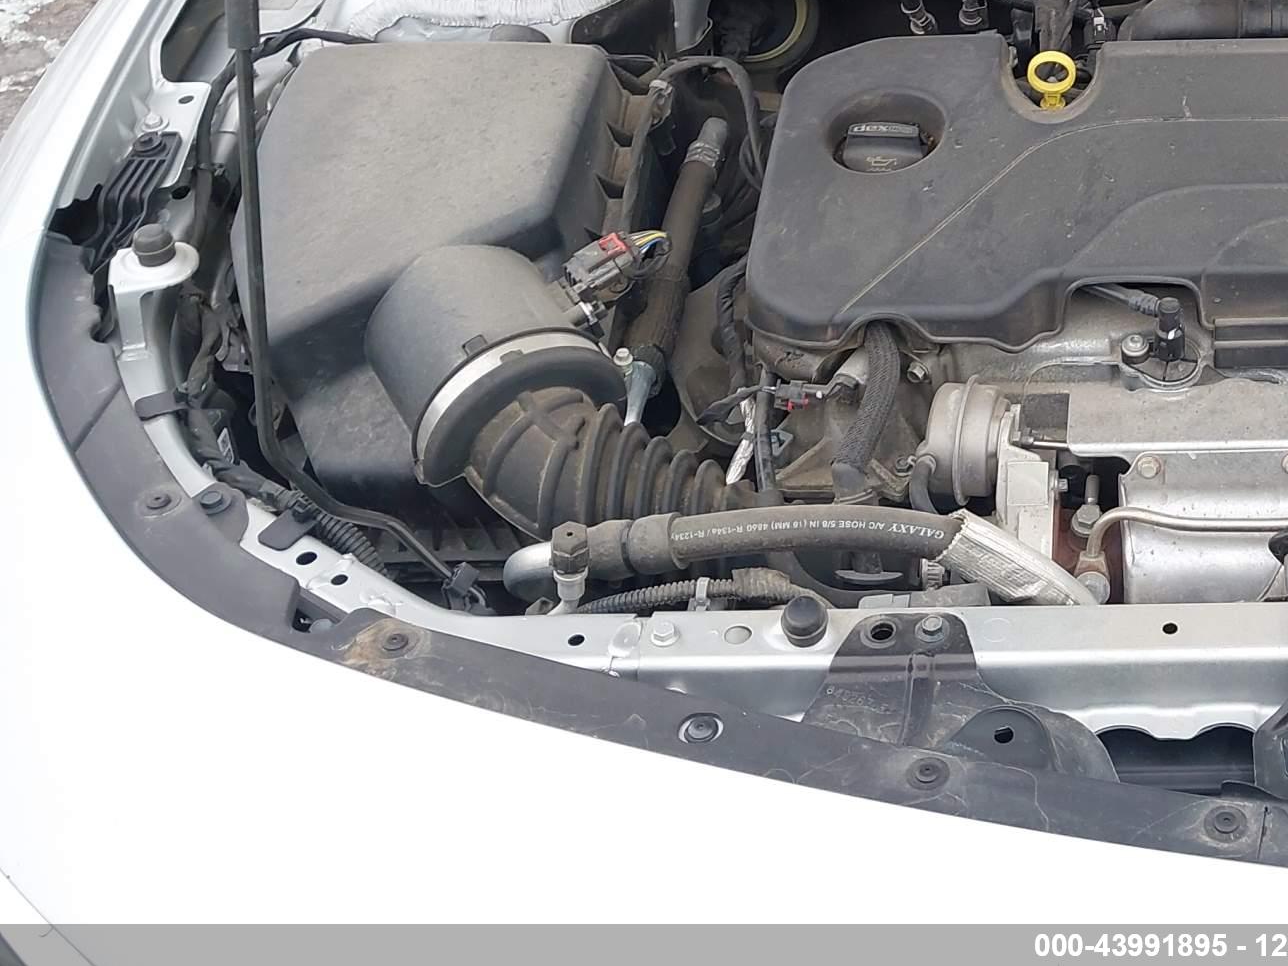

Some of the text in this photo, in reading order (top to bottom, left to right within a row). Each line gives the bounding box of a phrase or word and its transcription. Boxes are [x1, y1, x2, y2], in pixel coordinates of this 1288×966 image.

[771, 521, 790, 530] MM)
[809, 520, 820, 528] IN
[838, 520, 866, 529] HOSE
[868, 522, 886, 531] A/C
[888, 522, 945, 540] GALAXY
